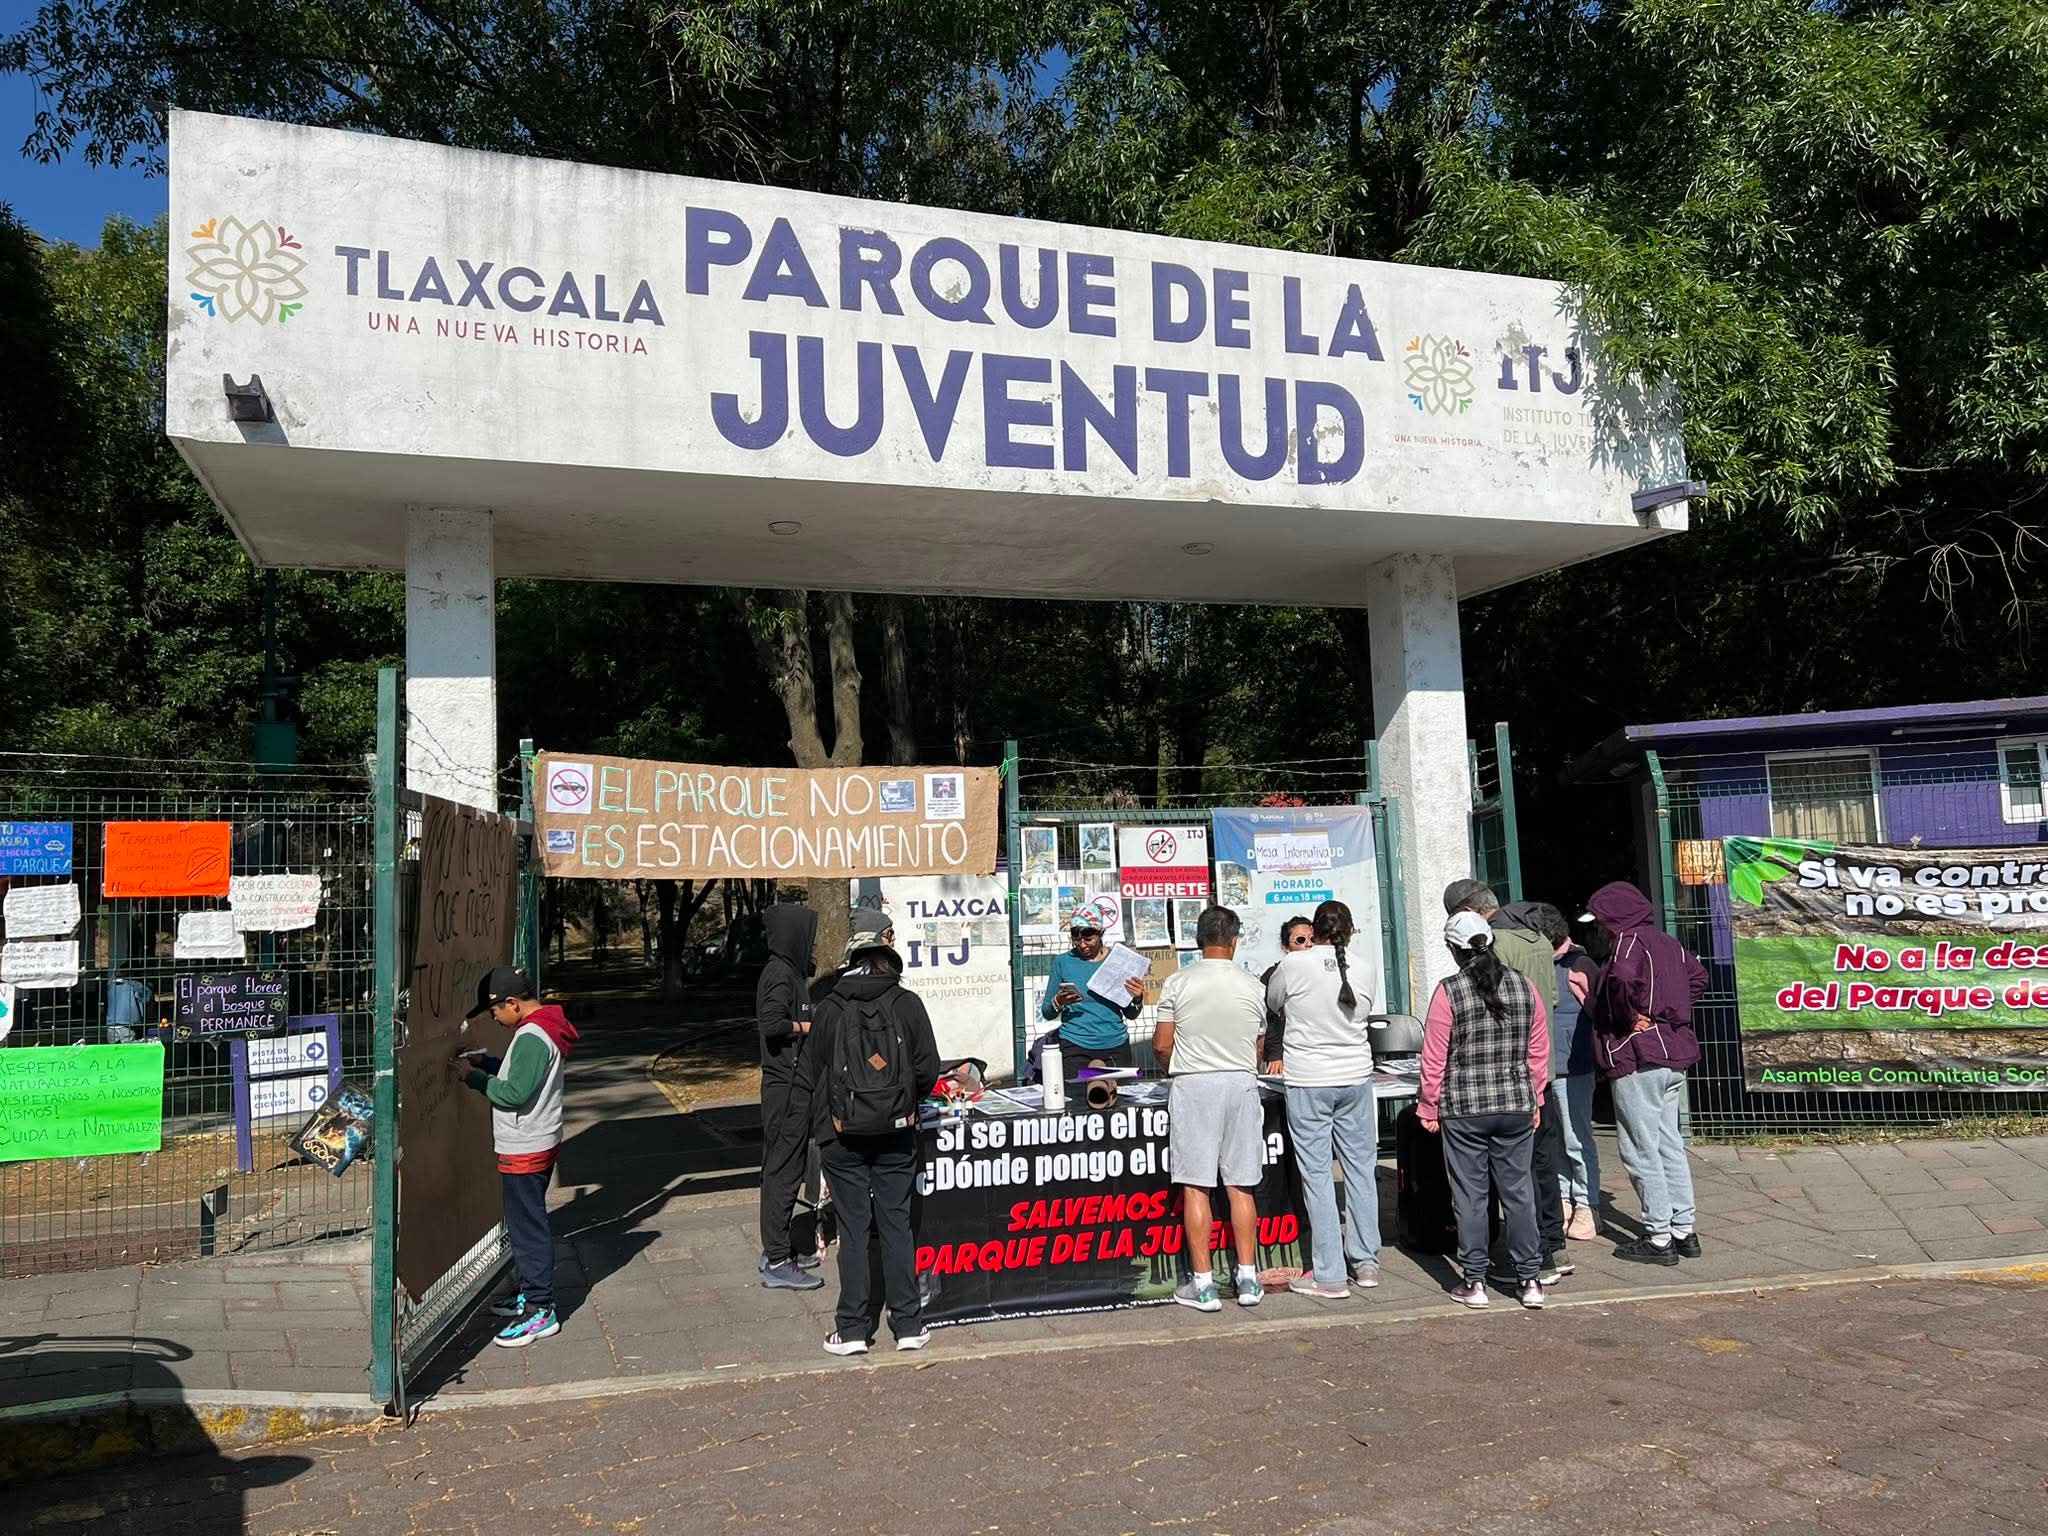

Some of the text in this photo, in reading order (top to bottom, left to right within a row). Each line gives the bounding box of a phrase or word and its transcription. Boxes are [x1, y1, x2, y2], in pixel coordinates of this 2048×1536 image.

[335, 245, 666, 326] TLAXCALA
[685, 206, 1384, 362] PARQUE DE LA
[368, 312, 648, 355] UNA NUEVA HISTORIA
[1496, 338, 1582, 395] ITJ
[710, 330, 1366, 486] JUVENTUD
[1503, 406, 1573, 426] INSTITUTO
[1394, 435, 1483, 448] UNA NUEVA HISTORIA
[1503, 429, 1630, 453] DE LA JUVENUD
[599, 766, 873, 819] EL PARQUE NO
[1186, 829, 1204, 839] ITJ
[582, 821, 967, 869] ES ESTACIONAMIENTO
[1256, 846, 1279, 858] Mesa
[1282, 843, 1329, 859] Informativa
[1798, 857, 1840, 889] Si
[1847, 863, 1902, 889] va
[257, 880, 274, 891] QUE
[1122, 882, 1208, 897] QUIERETE
[1273, 878, 1324, 889] HORARIO
[235, 894, 247, 902] LA
[1273, 894, 1279, 902] 6
[1300, 893, 1310, 902] 18
[1847, 891, 2048, 921] no es pro
[233, 906, 268, 917] espacios
[1834, 940, 2048, 971] No a la des
[181, 976, 282, 1003] El parque florece
[909, 976, 962, 987] INSTITUTO
[926, 989, 937, 998] LA
[939, 987, 991, 1000] JUVENTUD
[1776, 978, 2048, 1018] del Parque de
[181, 998, 265, 1015] si el bosque
[200, 1013, 275, 1032] PERMANECE
[252, 1049, 275, 1057] PISTA
[90, 1060, 100, 1071] A
[106, 1058, 126, 1071] LA
[100, 1074, 119, 1084] ES
[1760, 1067, 1863, 1085] Asamblea
[1868, 1066, 2000, 1085] Comunitaria
[97, 1090, 107, 1100] A
[112, 1086, 162, 1099] NOSOTROS
[0, 1126, 49, 1145] CUIDA
[56, 1127, 81, 1141] LA
[936, 1120, 965, 1152] Si
[971, 1119, 1007, 1150] se
[1110, 1107, 1137, 1140] el
[916, 1152, 1029, 1197] ¿Dónde
[1035, 1149, 1124, 1187] pongo
[1130, 1142, 1156, 1175] el
[1007, 1190, 1169, 1233] SALVEMOS
[914, 1213, 1300, 1276] PARQUE DE LA JUENUD
